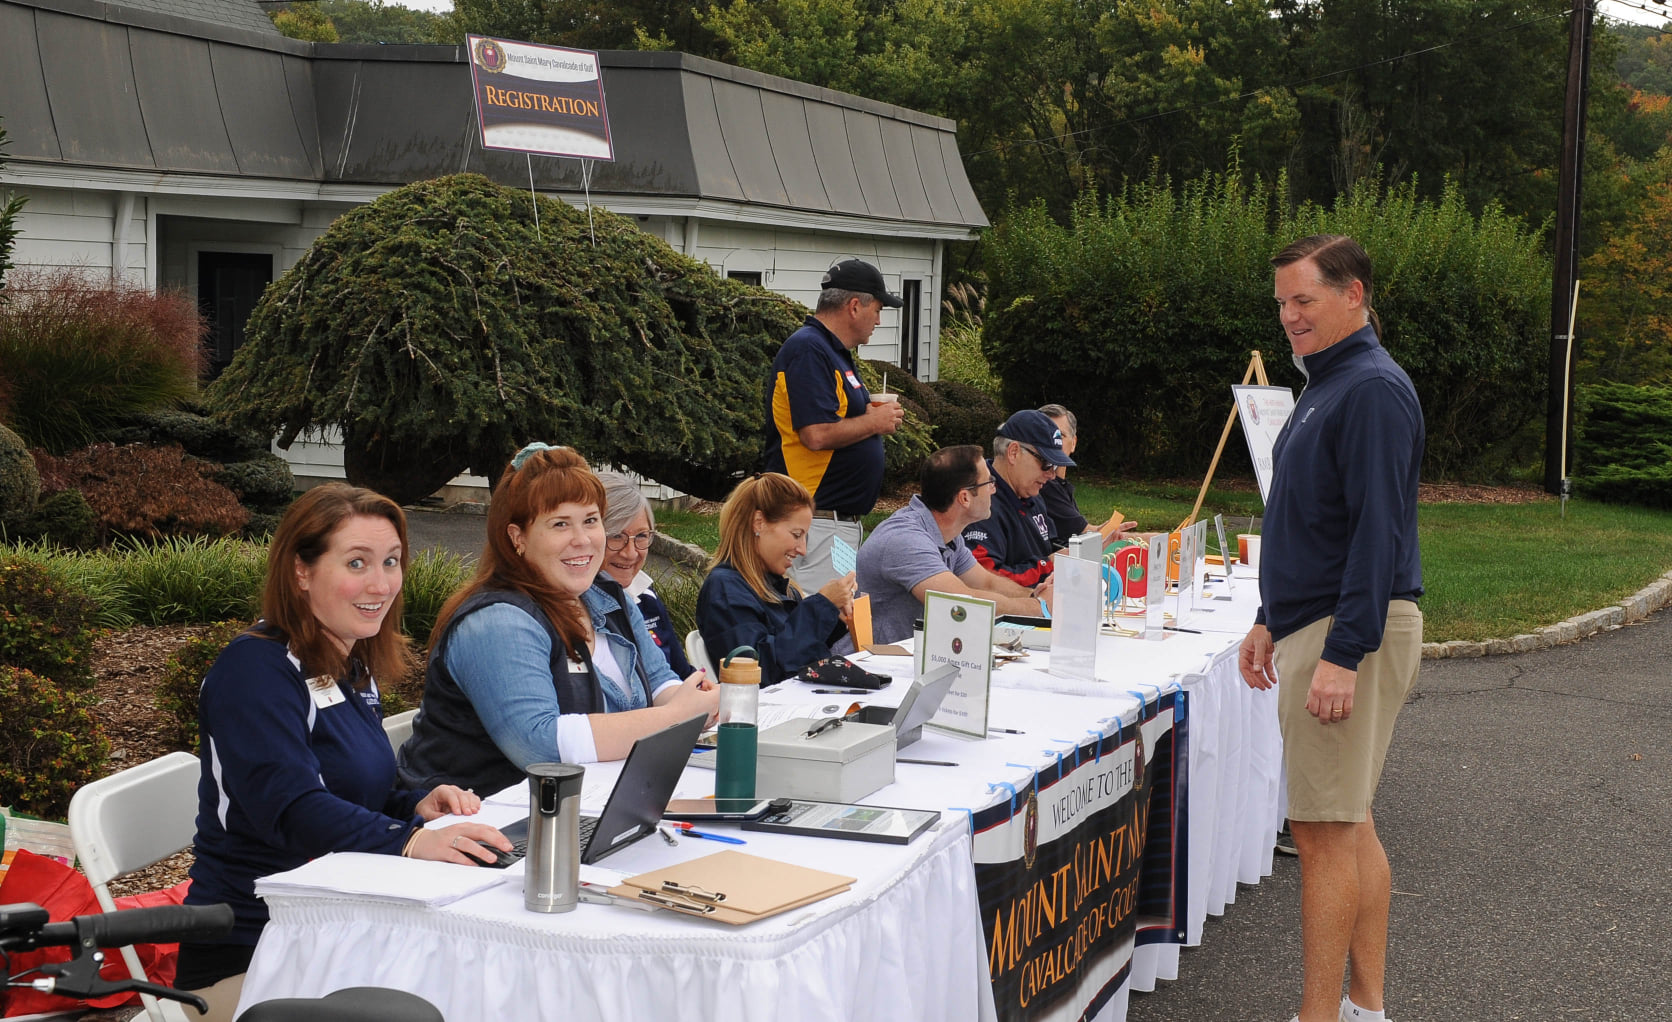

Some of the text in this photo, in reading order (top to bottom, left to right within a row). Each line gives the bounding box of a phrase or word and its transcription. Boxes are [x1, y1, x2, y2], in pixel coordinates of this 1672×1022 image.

[507, 53, 524, 64] Mount
[537, 57, 551, 69] Mary
[552, 59, 578, 71] Cavalcade
[485, 84, 599, 117] REGISTRATION
[961, 660, 970, 668] Gift
[970, 662, 982, 670] Card
[1052, 759, 1132, 830] WELCOME TO THE
[989, 862, 1071, 983] MOUNT
[1074, 824, 1127, 912] SAINT
[1020, 916, 1088, 1008] CAVALCADE
[1088, 902, 1107, 943] OF
